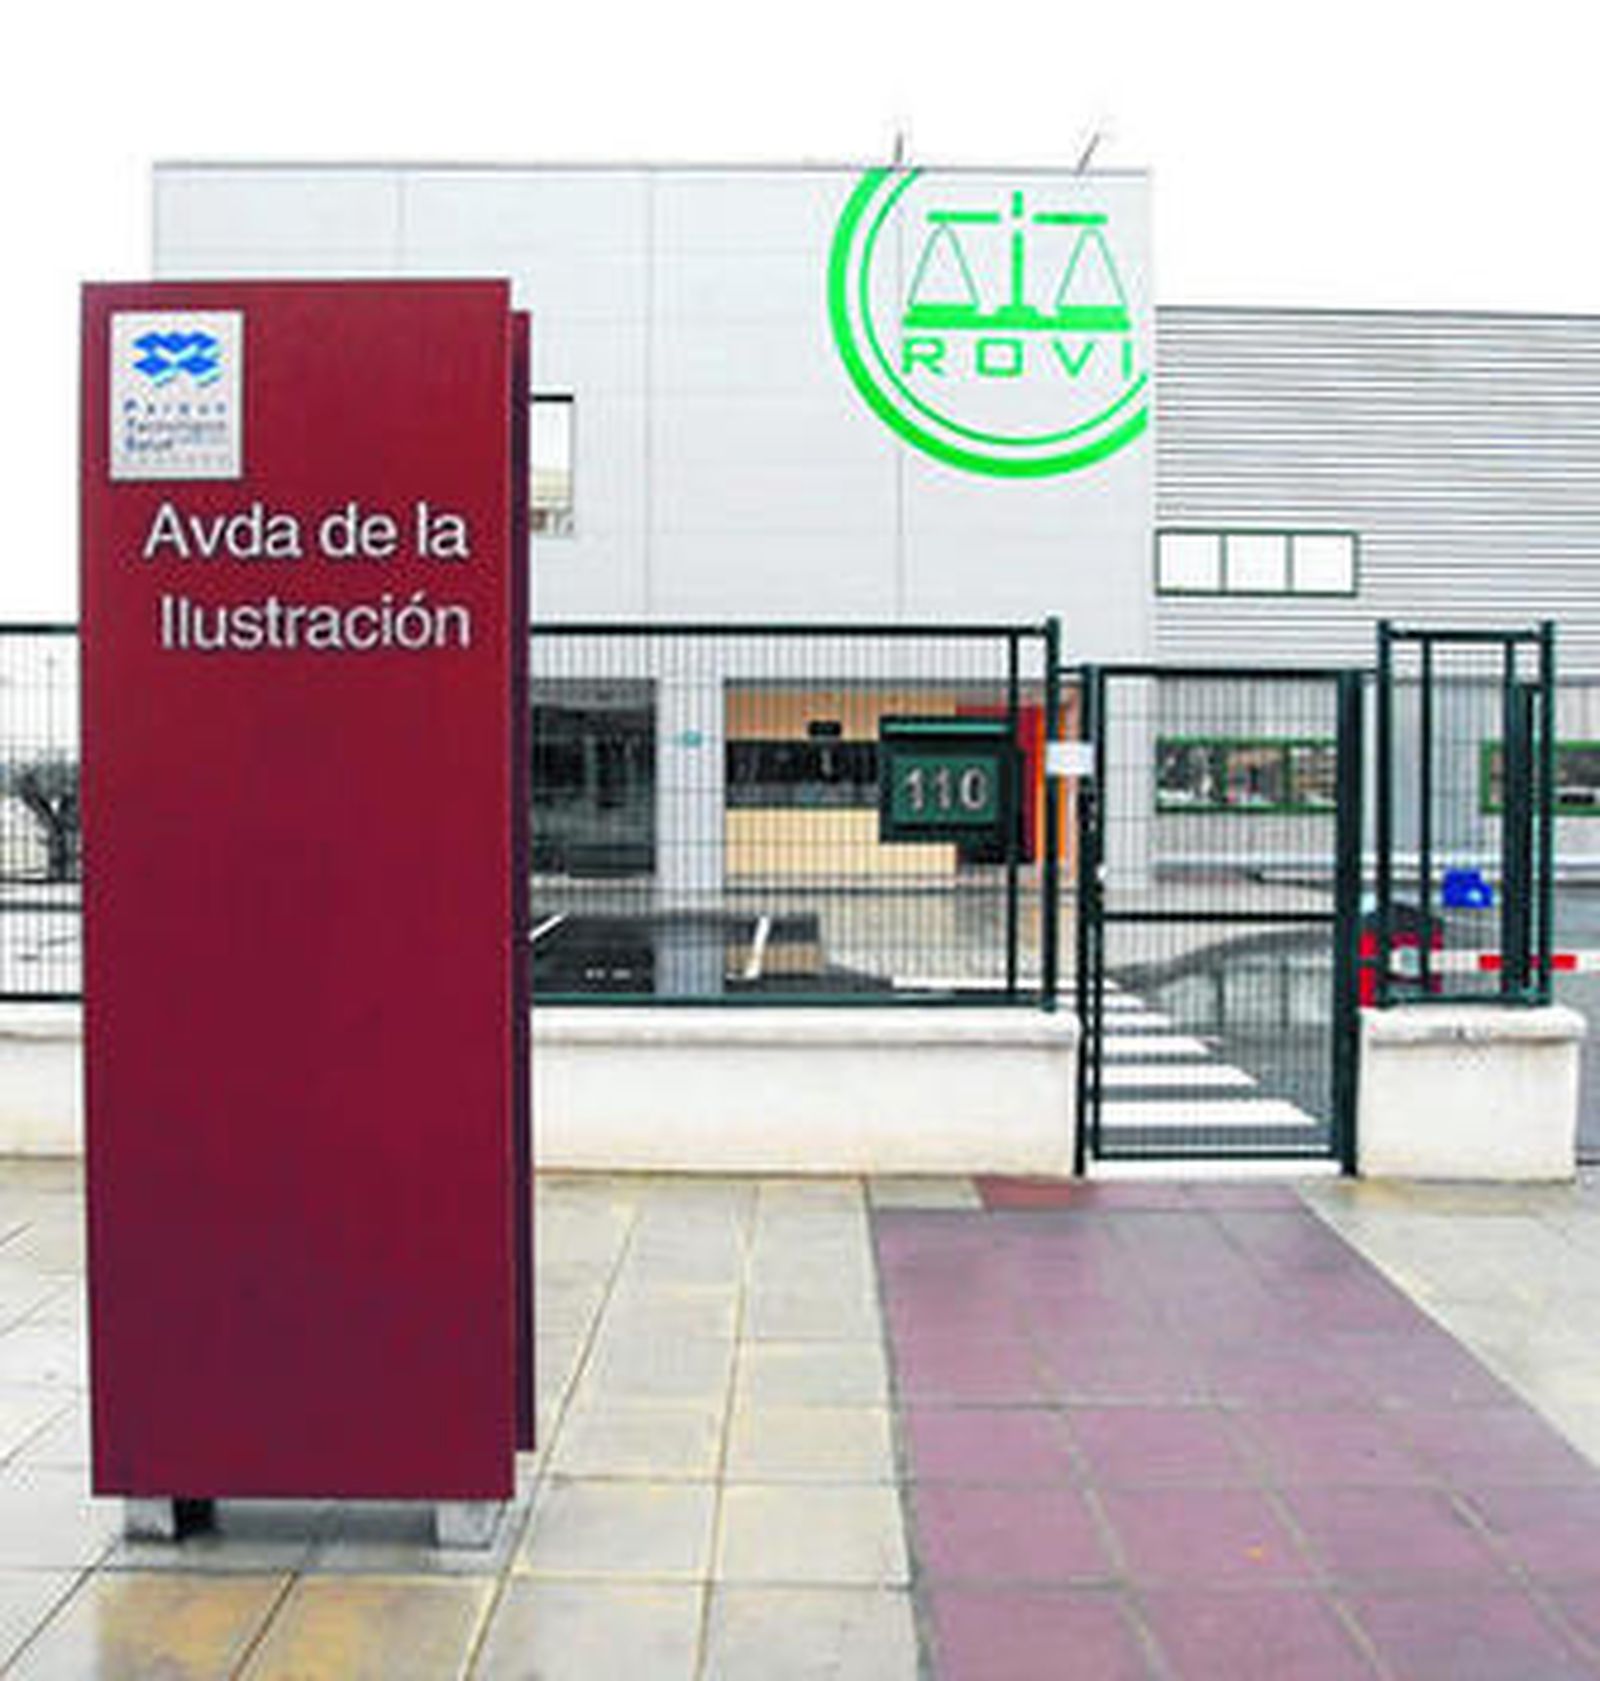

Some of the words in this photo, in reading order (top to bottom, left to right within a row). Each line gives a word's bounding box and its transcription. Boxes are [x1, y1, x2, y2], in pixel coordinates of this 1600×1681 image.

[903, 338, 1132, 379] ROVI
[144, 502, 302, 557] Avda
[320, 502, 398, 556] de
[417, 502, 469, 557] la
[161, 590, 471, 649] Ilustración
[906, 768, 987, 811] 110
